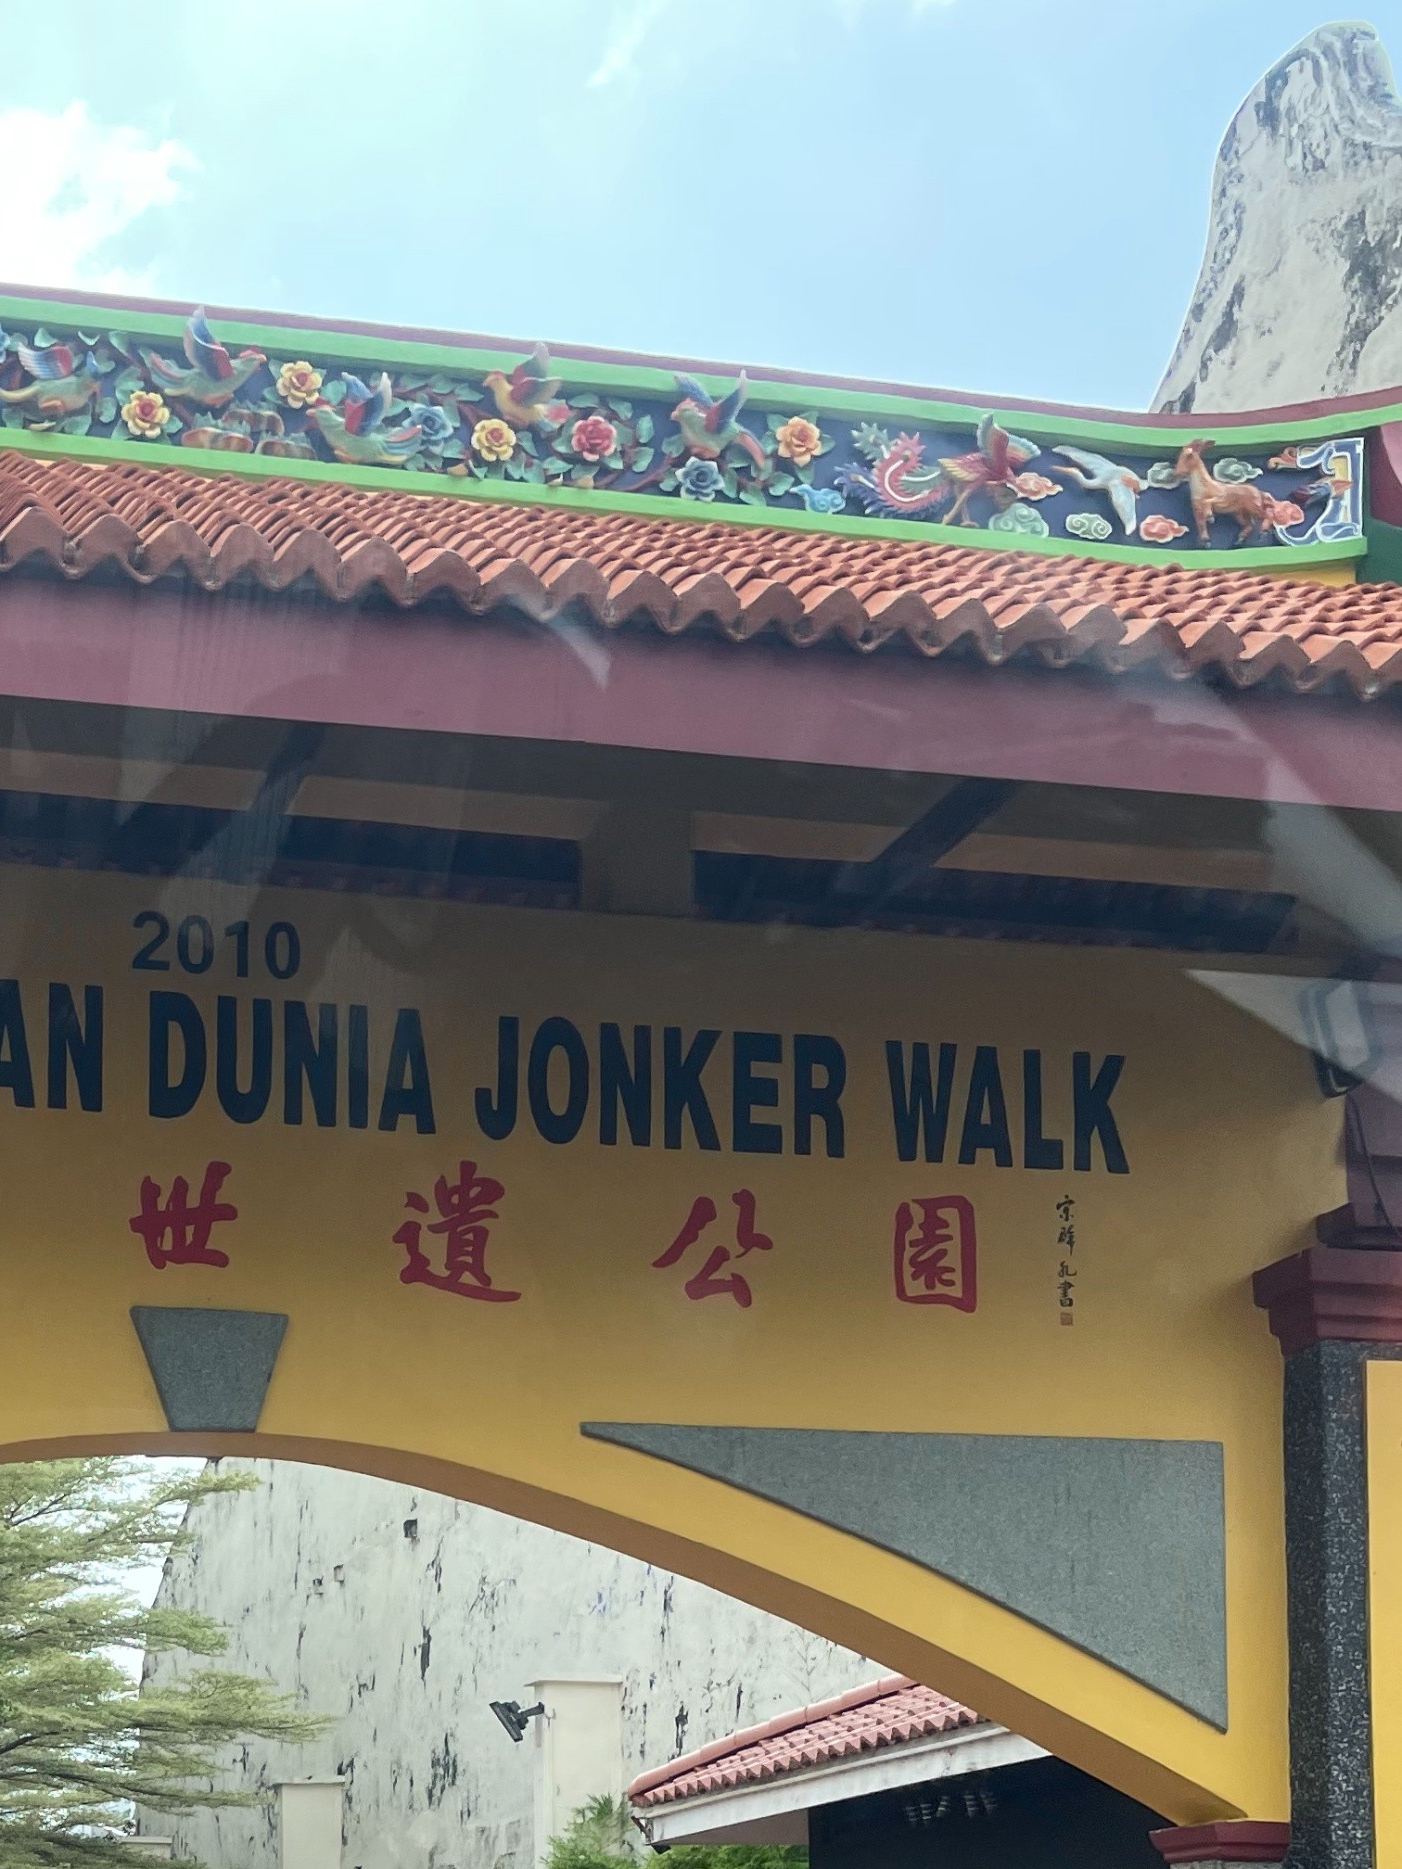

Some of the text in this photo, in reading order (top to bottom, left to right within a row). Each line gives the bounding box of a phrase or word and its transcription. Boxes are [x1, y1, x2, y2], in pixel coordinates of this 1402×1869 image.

[132, 910, 301, 980] 2010
[148, 990, 436, 1135] DUNIA
[474, 1015, 847, 1159] JONKER
[884, 1039, 1131, 1175] WALK
